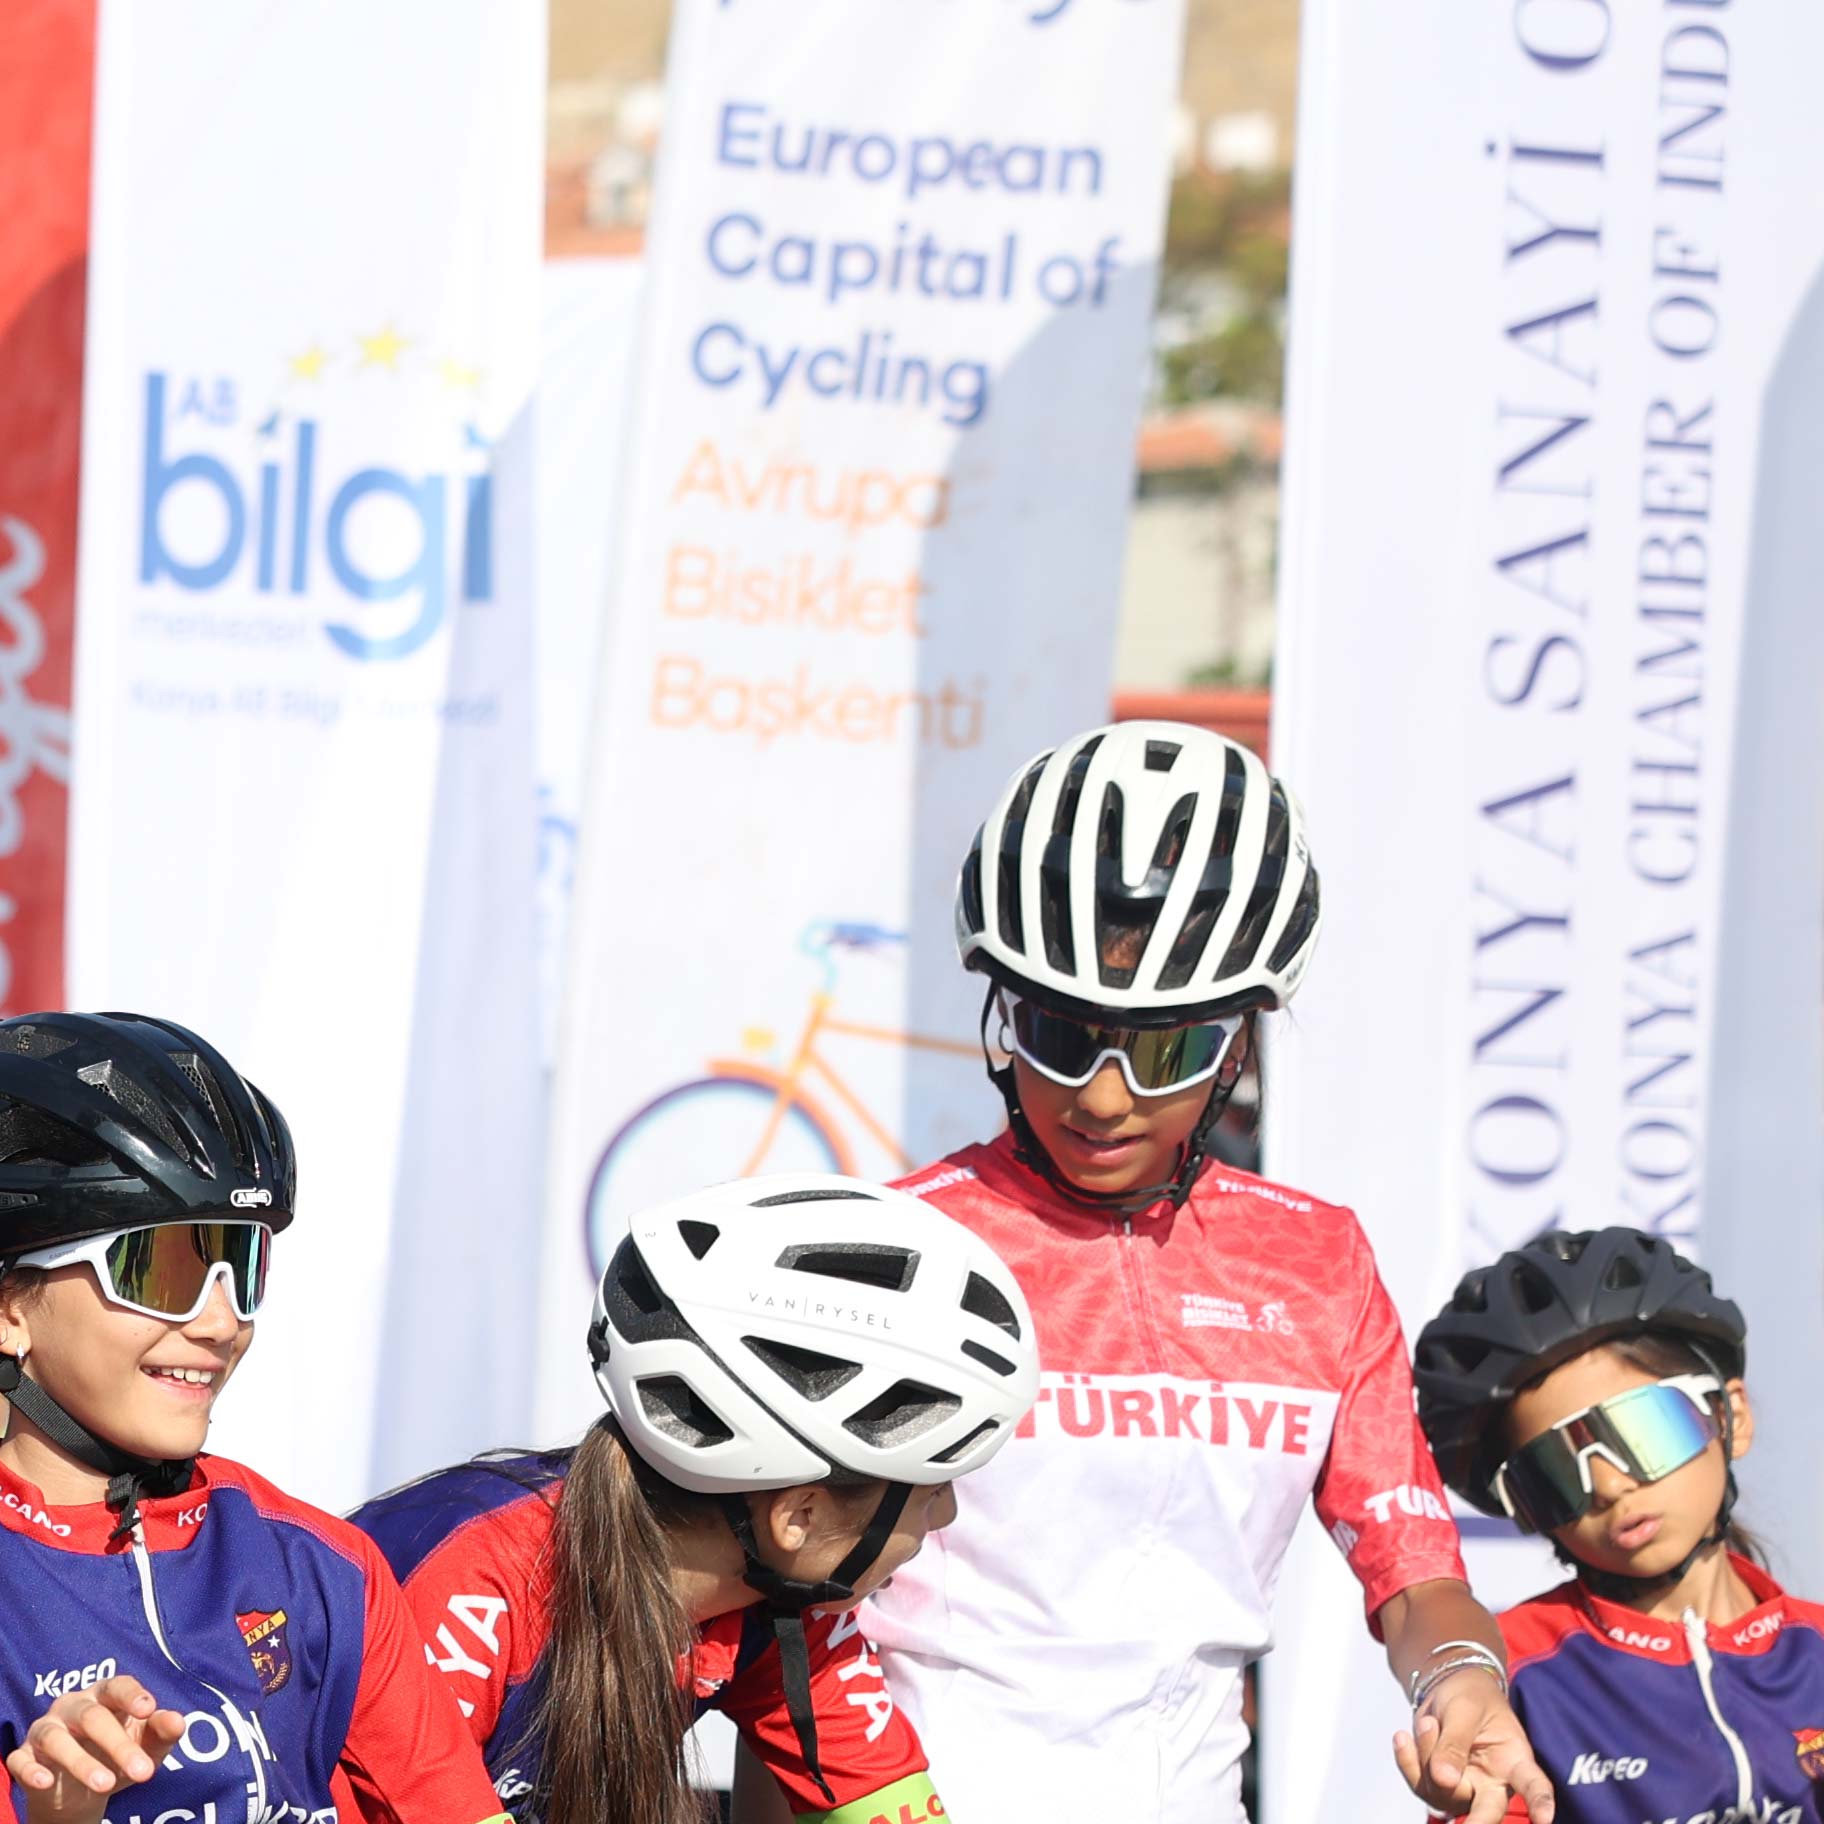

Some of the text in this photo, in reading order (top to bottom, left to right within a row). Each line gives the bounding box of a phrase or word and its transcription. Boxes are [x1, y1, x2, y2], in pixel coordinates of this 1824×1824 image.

[718, 102, 1104, 198] European
[707, 212, 1122, 308] Capital of
[1646, 224, 1724, 361] OF
[692, 321, 990, 427] Cycling
[1483, 136, 1607, 717] SANAYİ
[138, 369, 495, 662] bilgi
[671, 438, 951, 533] Avrupa
[661, 543, 936, 641] Bisiklet
[1626, 396, 1713, 889] CHAMBER
[648, 654, 987, 752] Başkenti
[1014, 1373, 1314, 1457] TÜRKİYE
